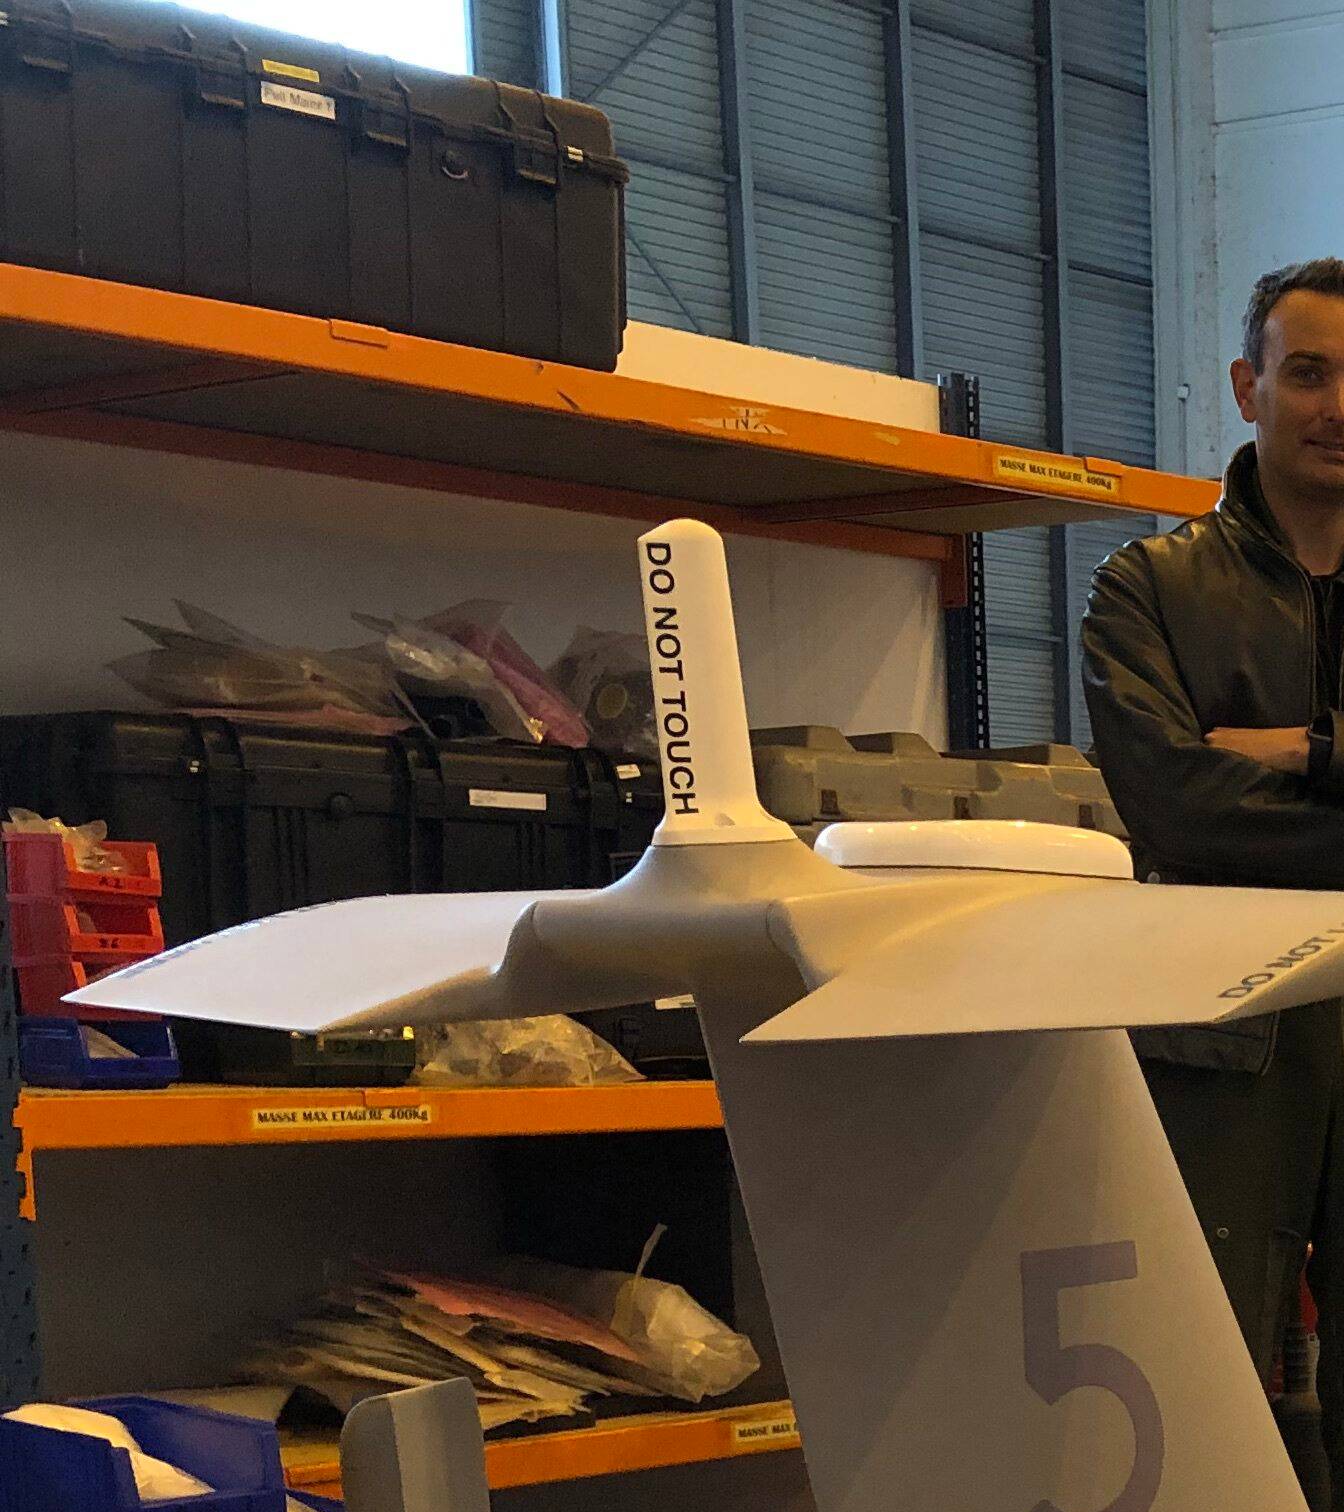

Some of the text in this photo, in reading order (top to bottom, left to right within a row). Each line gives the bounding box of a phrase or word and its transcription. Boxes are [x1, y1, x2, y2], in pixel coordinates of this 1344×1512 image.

[1029, 463, 1046, 476] MAX
[645, 541, 700, 816] DO NOT TOUCH
[257, 1111, 298, 1123] MASSE
[303, 1110, 328, 1121] MAX
